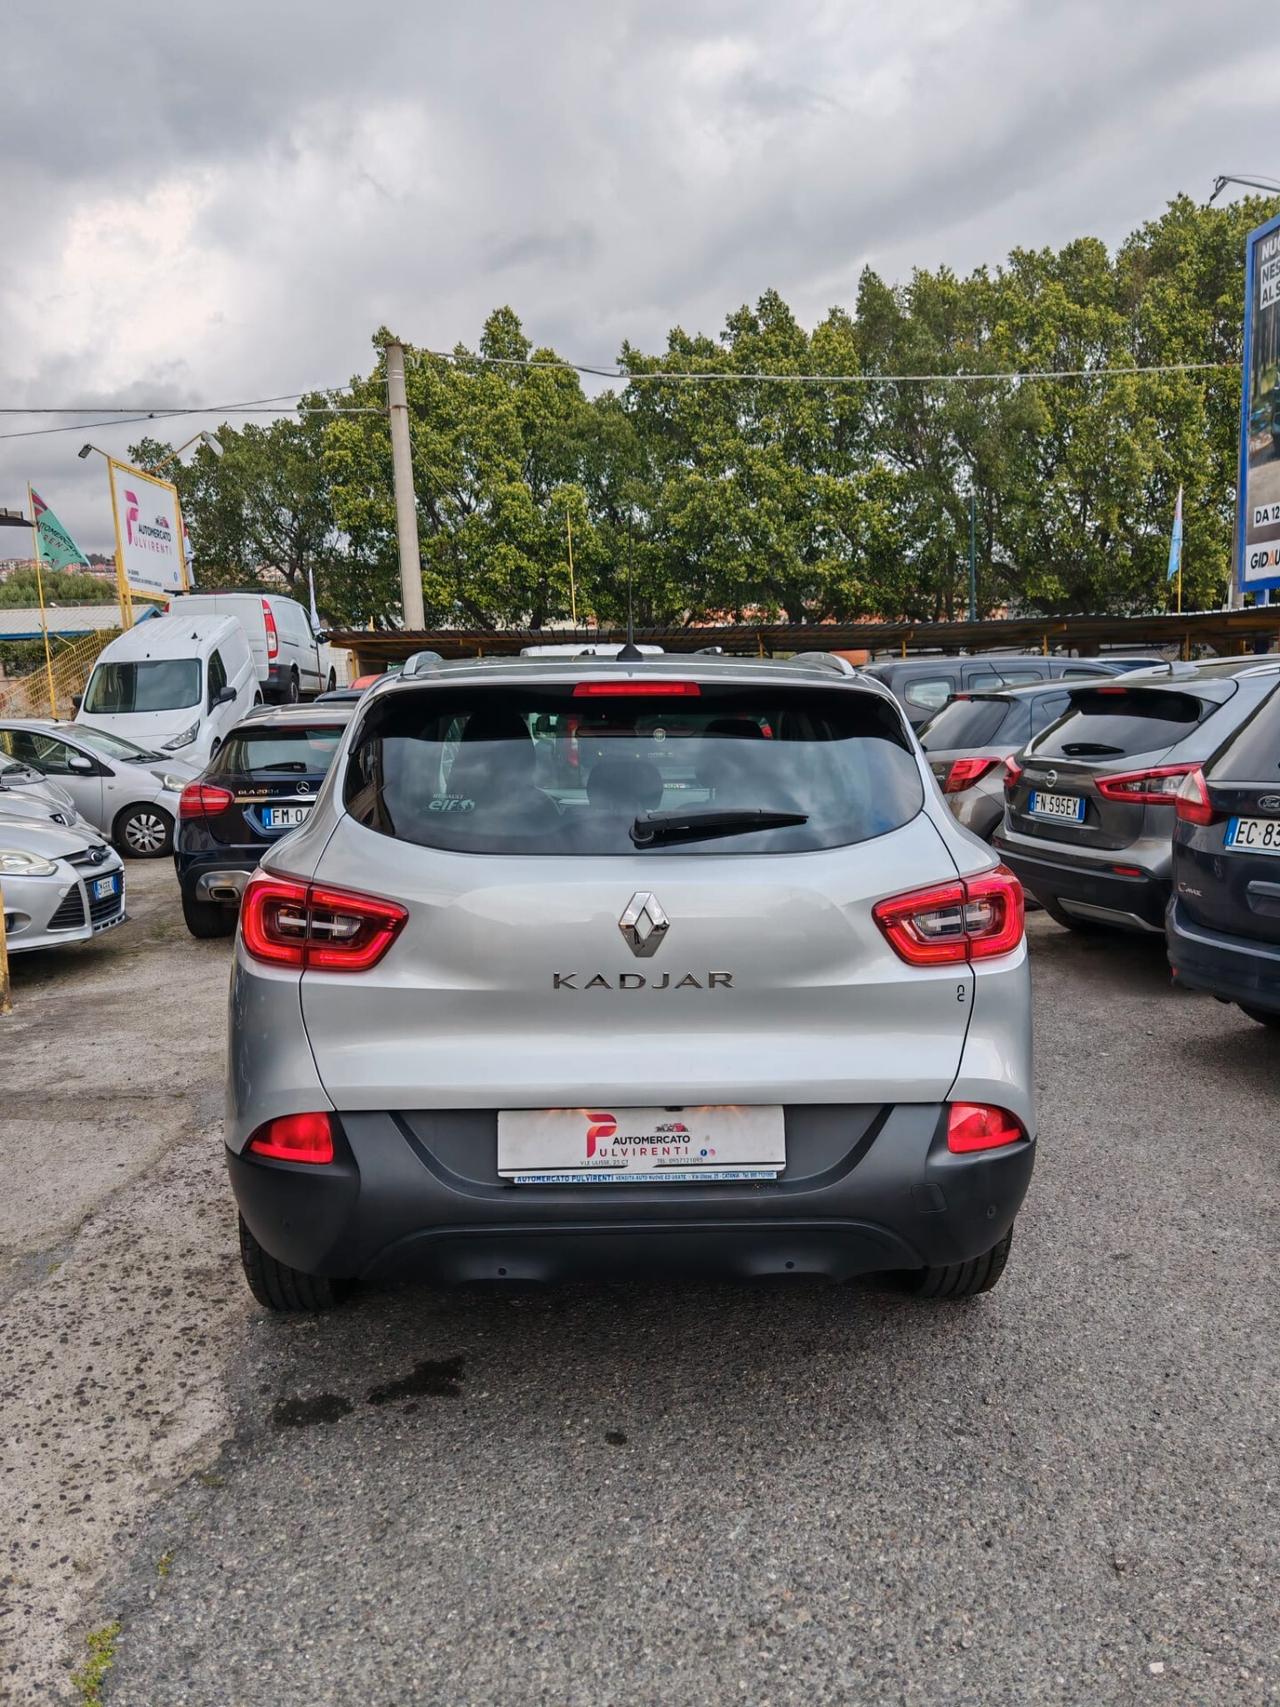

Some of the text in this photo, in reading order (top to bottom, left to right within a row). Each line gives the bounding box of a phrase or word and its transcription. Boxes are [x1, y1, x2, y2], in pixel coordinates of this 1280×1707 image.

[1262, 285, 1274, 305] AL
[1255, 508, 1270, 524] DA
[138, 524, 172, 543] AUTOMERCATO
[428, 799, 460, 810] elf
[272, 809, 290, 824] FM
[1235, 820, 1258, 844] EC
[553, 971, 735, 990] KADJAR
[612, 1134, 691, 1146] AUTOMERCATO
[517, 1175, 569, 1184] AUTOMERCATO
[571, 1174, 614, 1183] PULVIRENTI
